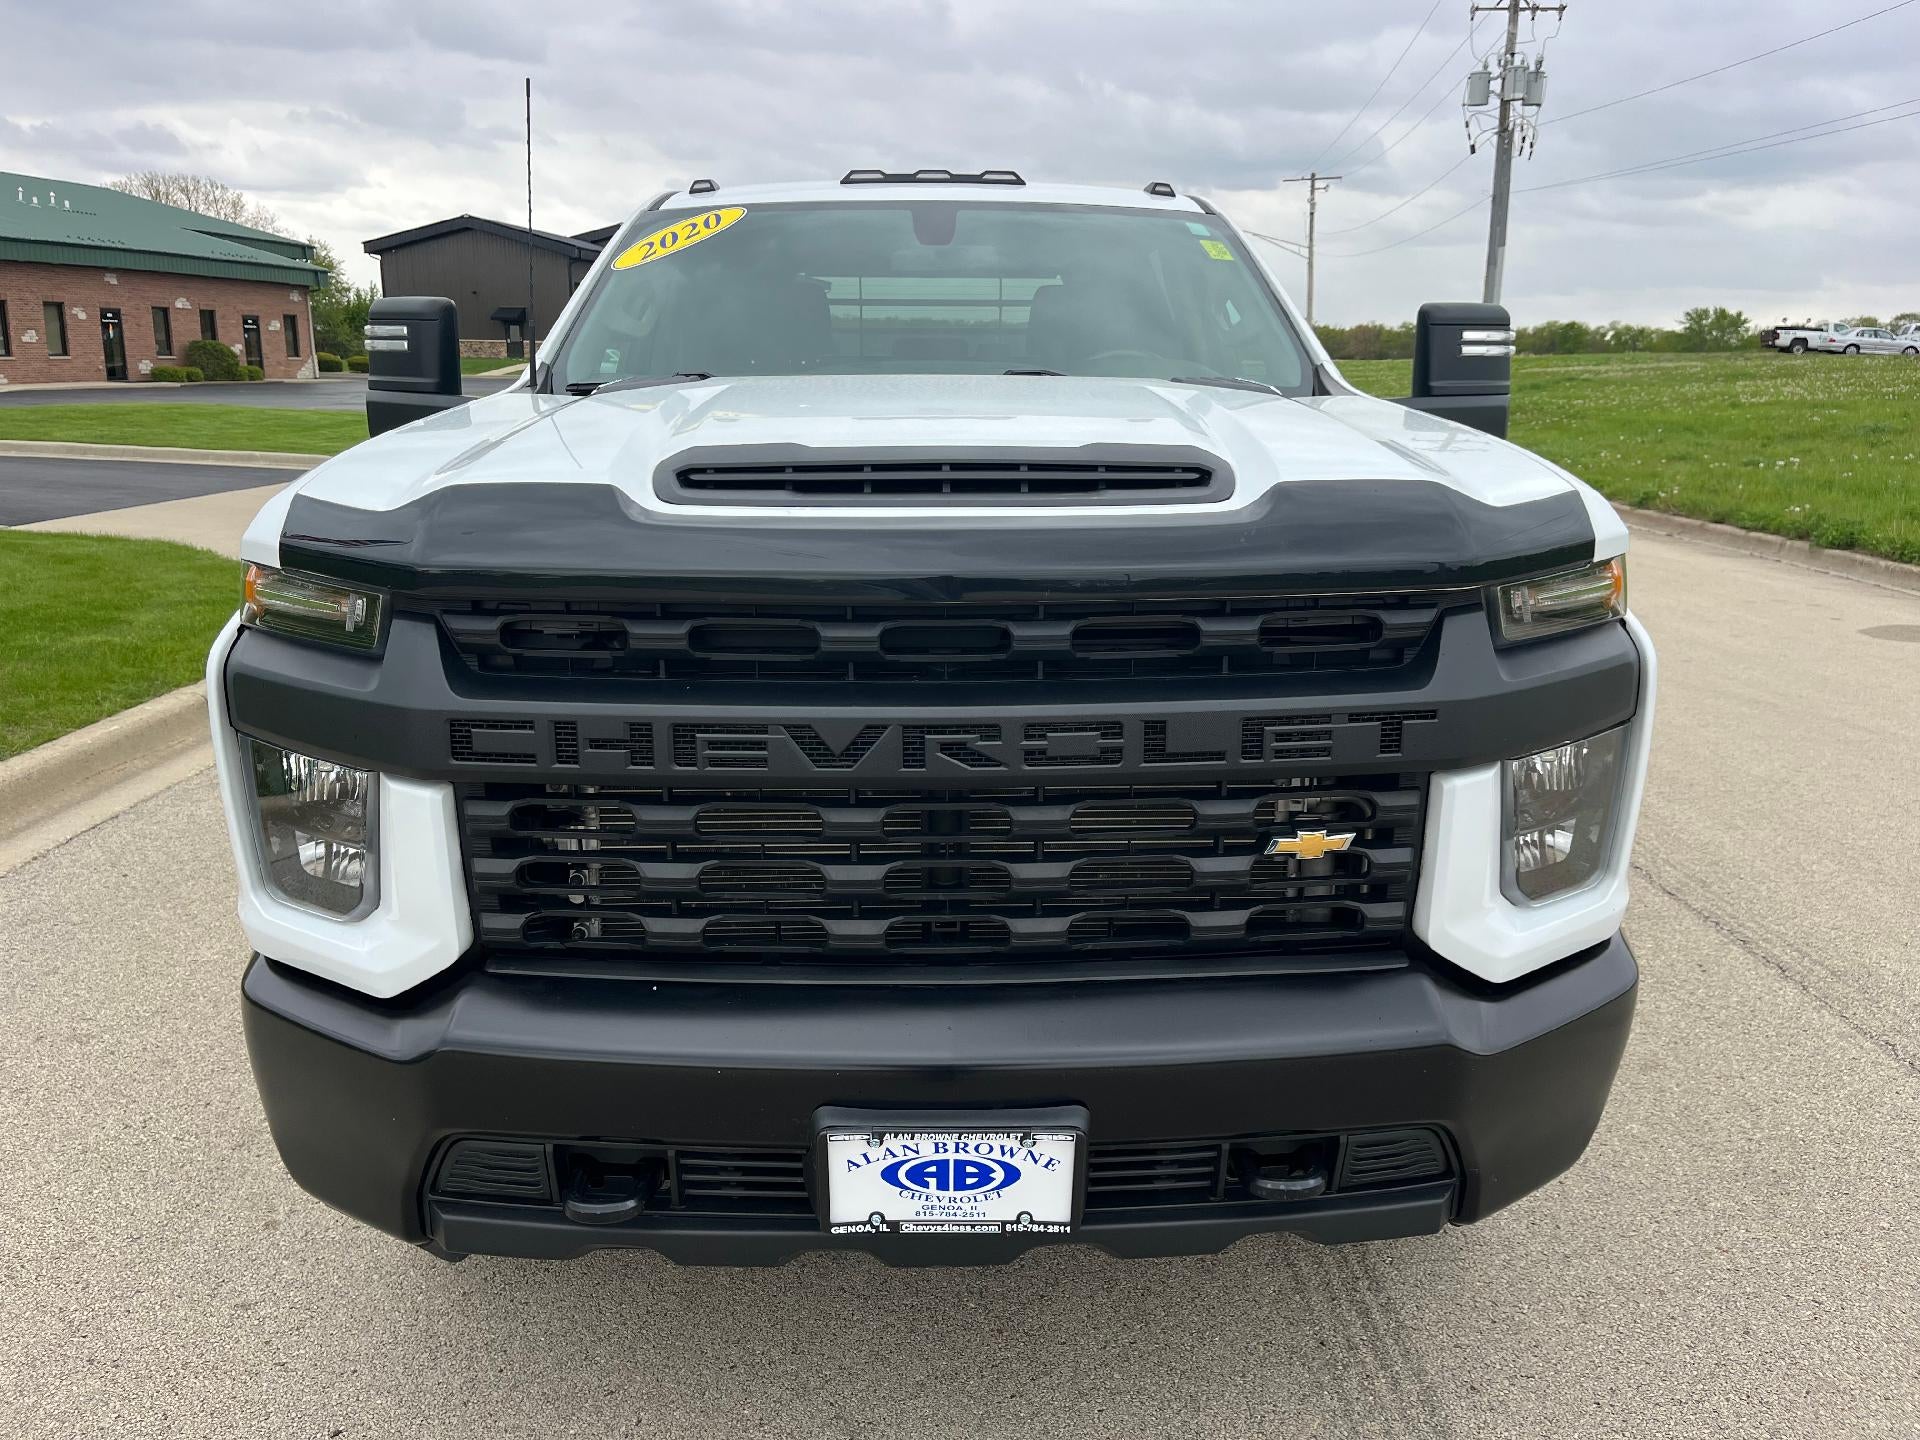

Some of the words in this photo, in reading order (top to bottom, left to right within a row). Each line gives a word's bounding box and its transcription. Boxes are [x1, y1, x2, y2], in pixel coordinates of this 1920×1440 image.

[638, 213, 722, 261] 2020
[449, 709, 1438, 770] CHEVROLET
[882, 1133, 911, 1141] ALAN
[914, 1133, 959, 1141] BROWNE
[961, 1133, 1024, 1141] CHEVROLET
[846, 1142, 920, 1173] ALAN
[932, 1141, 1061, 1172] BROWNE
[899, 1189, 1003, 1204] CHEVROLET
[831, 1224, 876, 1234] GENOA,
[879, 1223, 890, 1232] IL
[901, 1223, 999, 1232] Chevys4less.com
[1005, 1223, 1071, 1233] 815-784-2511
